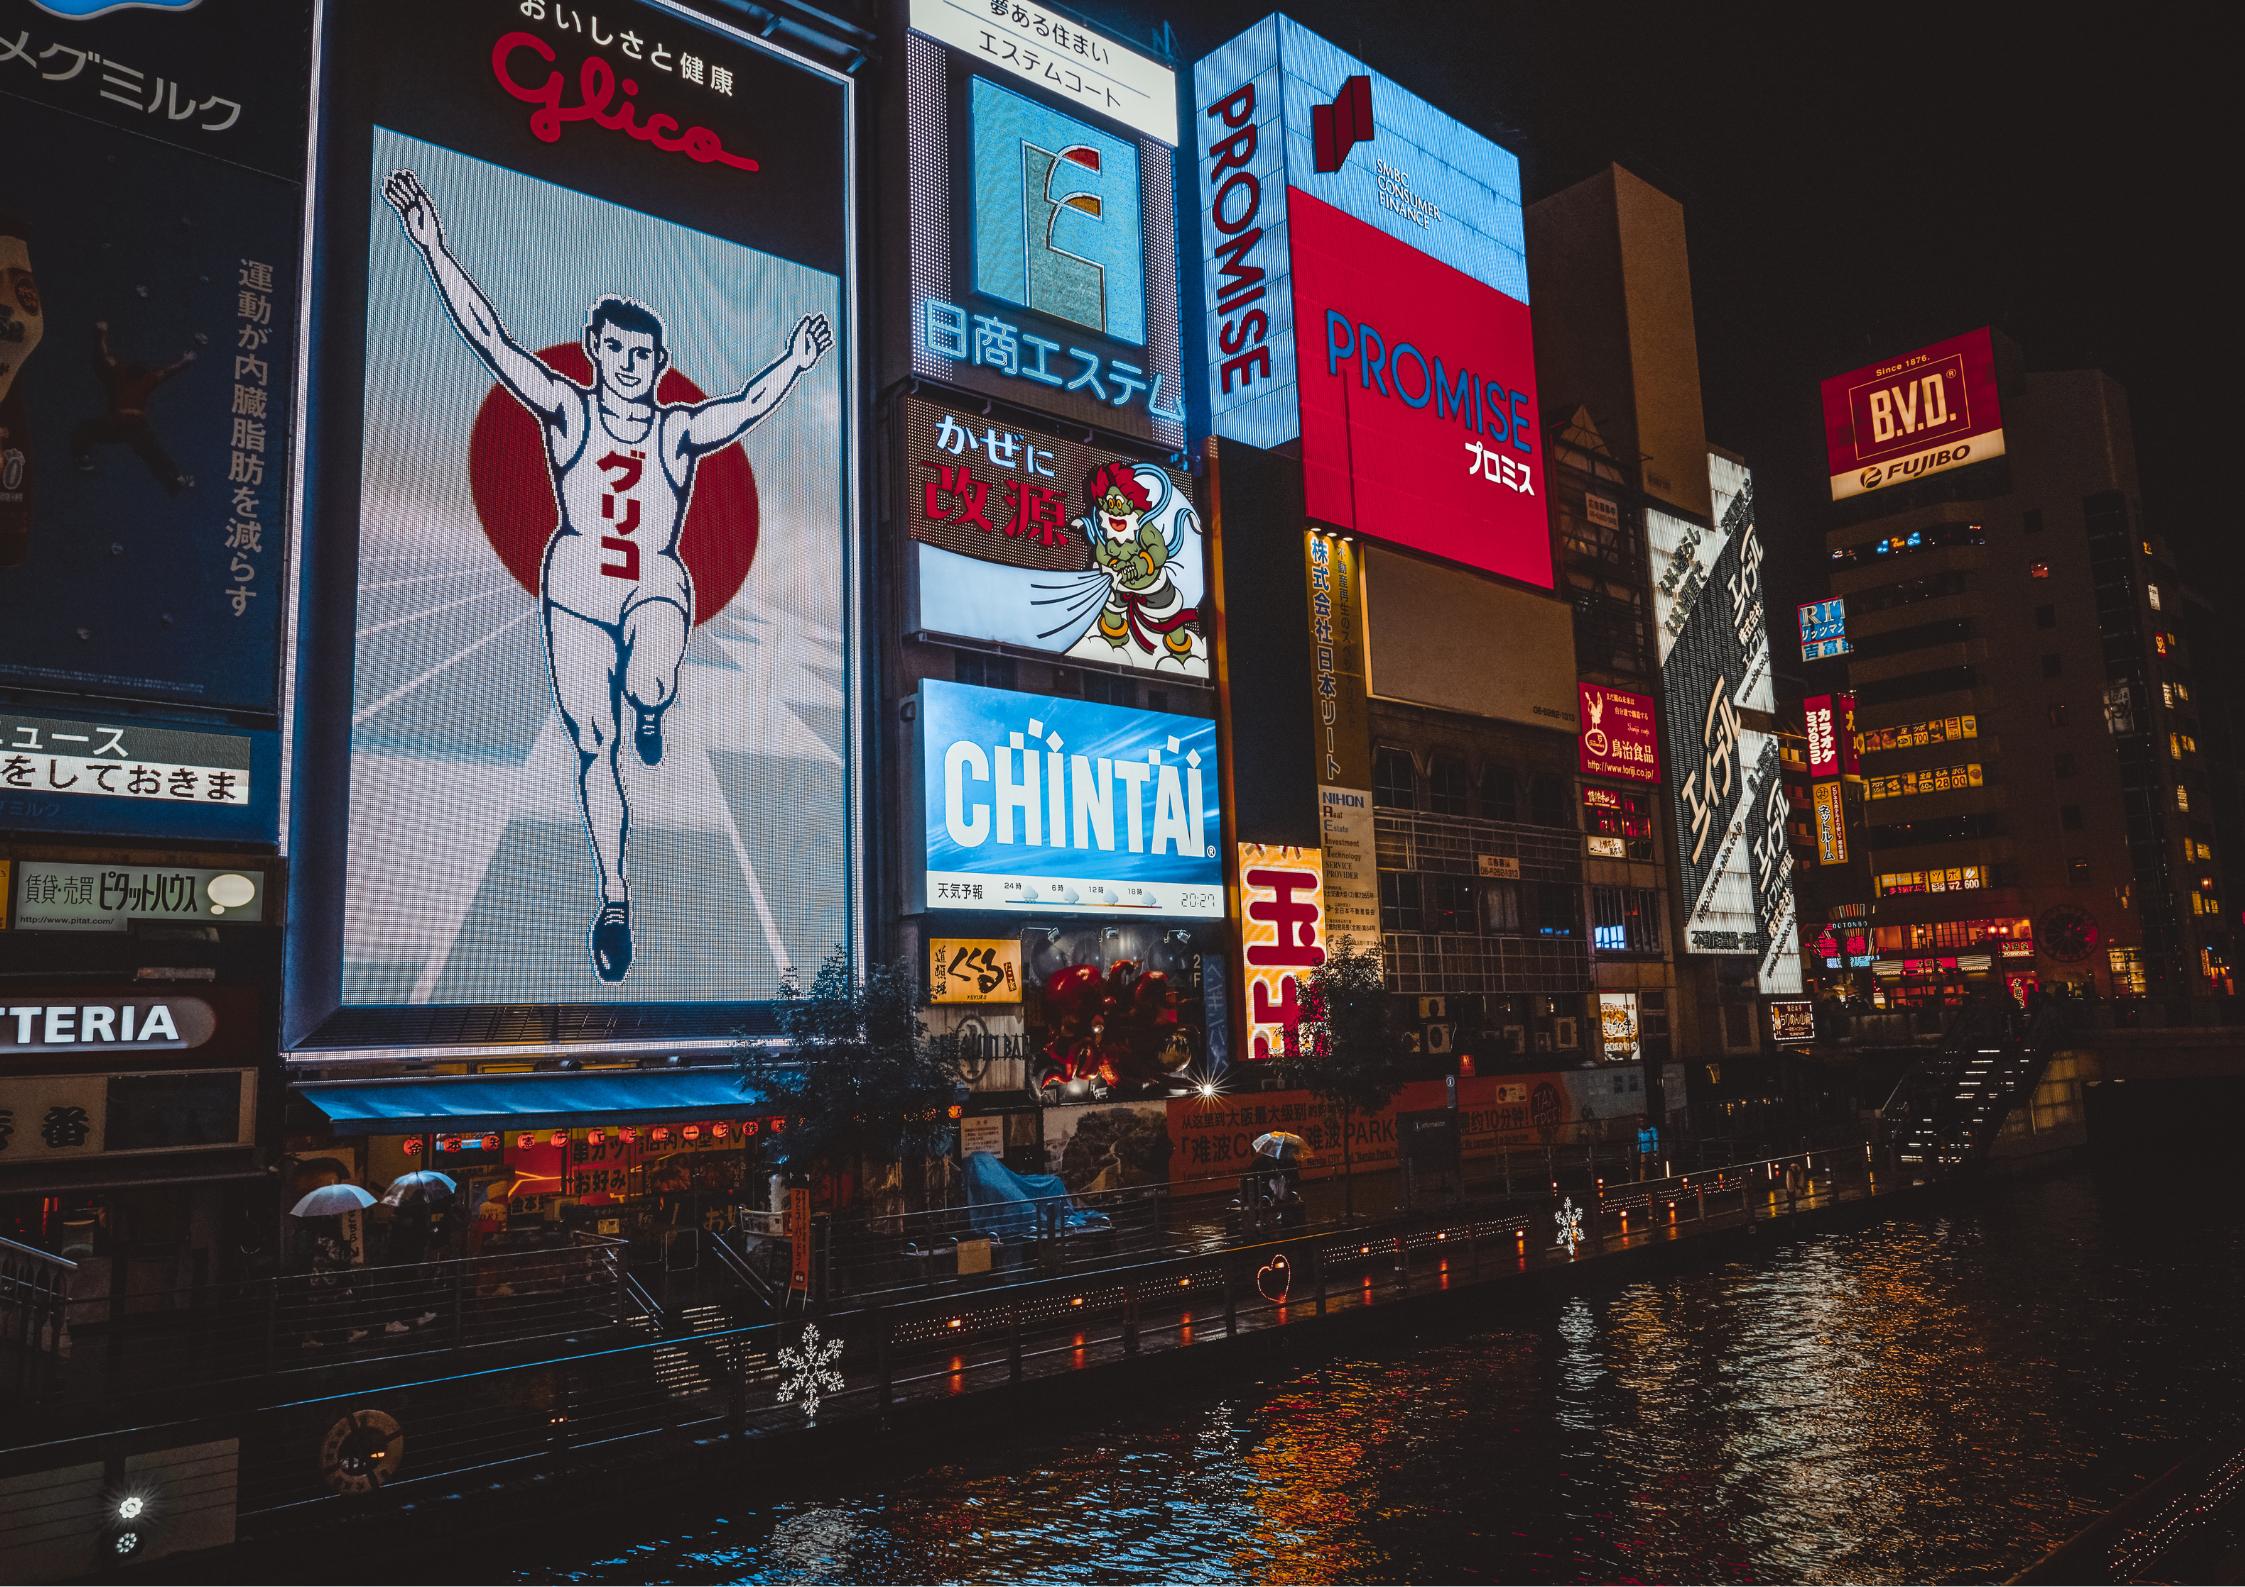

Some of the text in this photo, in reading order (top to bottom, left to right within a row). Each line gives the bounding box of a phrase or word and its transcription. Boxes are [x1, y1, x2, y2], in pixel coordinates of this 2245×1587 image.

[520, 0, 733, 96] おいしさと健康
[990, 0, 1109, 65] 夢ある住まい
[0, 30, 242, 132] メグミルク
[979, 30, 1121, 108] エステムコート
[1375, 159, 1409, 186] SMBC
[1376, 175, 1442, 222] CONSUMER
[1378, 190, 1430, 230] FINANCE
[1207, 83, 1271, 394] PROMISE
[925, 297, 1187, 423] 日商エステム
[1325, 308, 1533, 453] PROMISE
[1876, 354, 1931, 377] Since 1876.
[1869, 372, 1957, 443] B.V.D.
[225, 258, 273, 617] 運動が内臓脂肪を減らす
[934, 414, 1056, 477] かぜに
[1464, 440, 1536, 496] プロミス
[1887, 444, 1971, 479] FUJIBO
[596, 449, 646, 581] グリコ
[920, 460, 1070, 547] 改源
[1311, 538, 1341, 781] 株式会社日本リート
[0, 726, 128, 758] ュース
[1806, 711, 1823, 765] JOYSOUND
[1817, 708, 1836, 763] カラオケ
[1, 755, 236, 800] をしておきま
[944, 718, 1205, 858] CHINTAI
[1323, 792, 1365, 808] NIHON
[1323, 805, 1343, 819] Real
[1818, 805, 1835, 860] ネットルーム
[1325, 832, 1360, 848] Investment
[1325, 846, 1361, 861] Technology
[100, 871, 198, 913] ピタットハウス
[938, 882, 984, 900] 天気予報
[1004, 882, 1022, 890] 24時
[1051, 884, 1064, 893] 6時
[1088, 886, 1104, 895] 12時
[1128, 887, 1143, 896] 18時
[20, 915, 114, 925] http://www.pitat.com/
[947, 946, 1005, 994] くくる
[0, 1005, 181, 1044] TERIA
